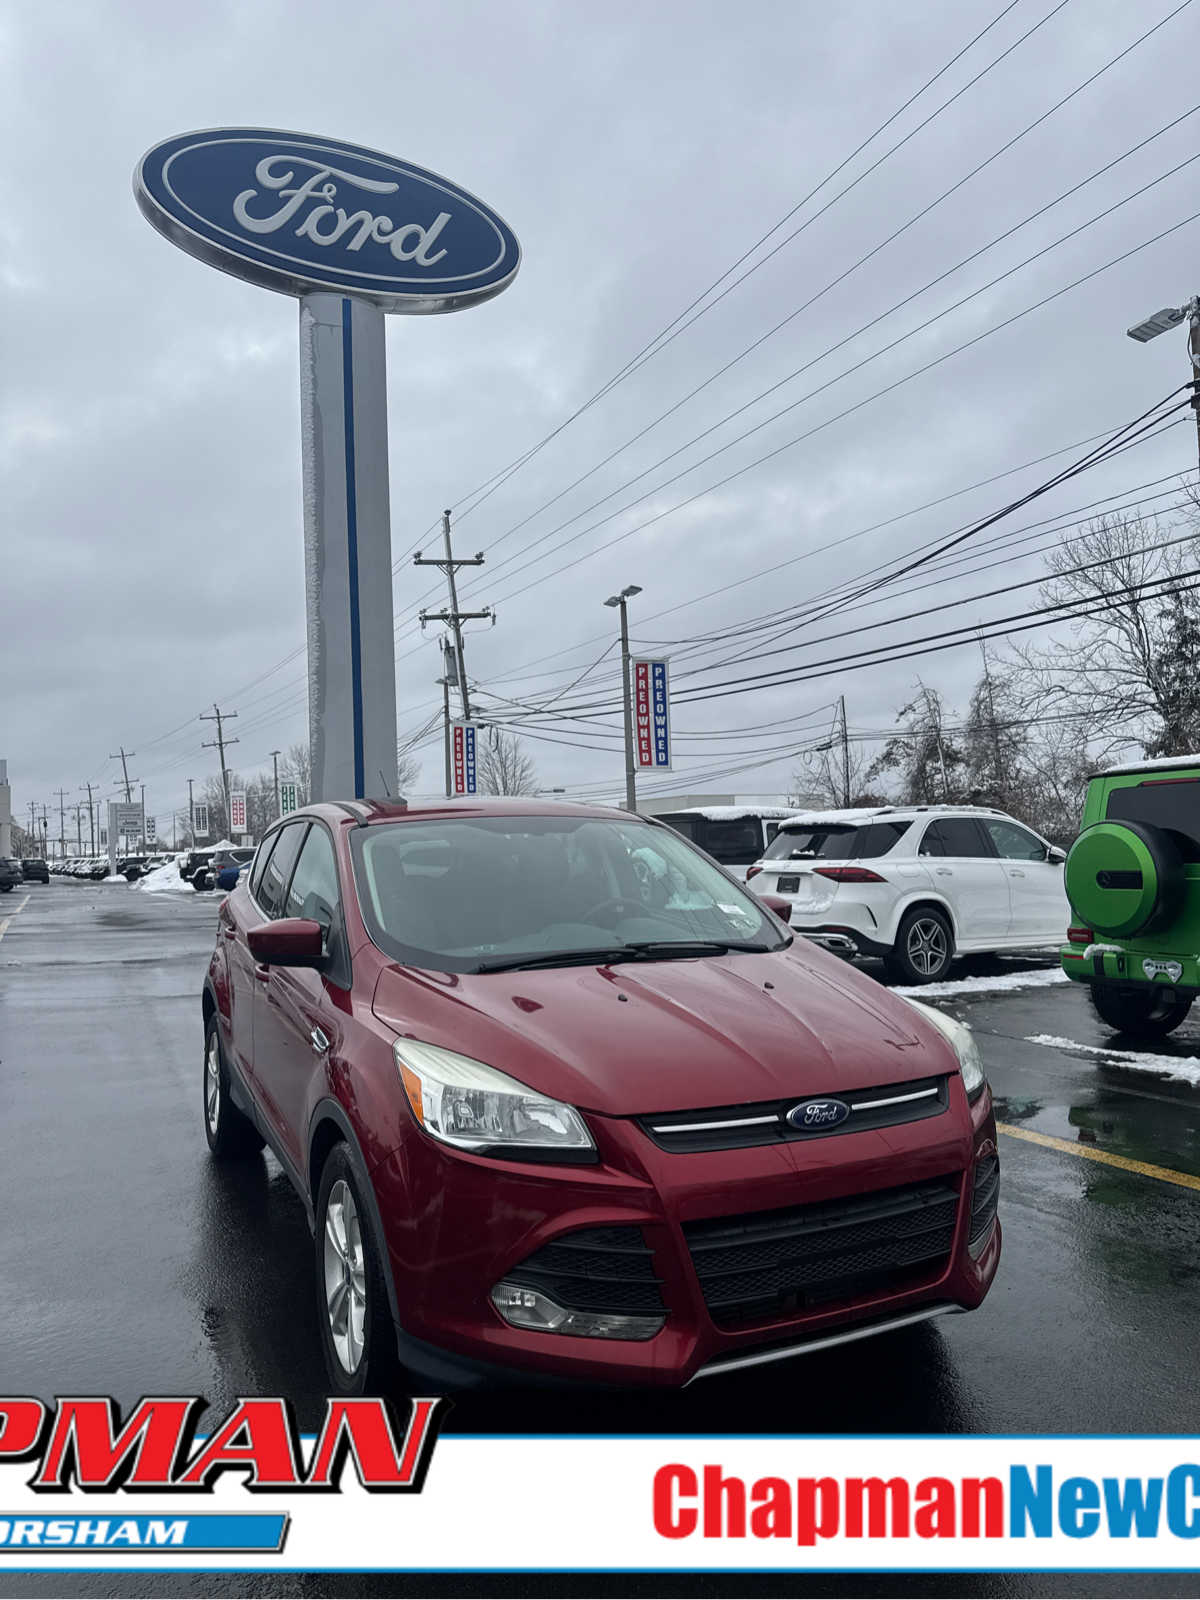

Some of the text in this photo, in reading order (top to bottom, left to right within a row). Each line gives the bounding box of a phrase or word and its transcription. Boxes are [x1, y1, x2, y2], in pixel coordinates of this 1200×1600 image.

[233, 155, 452, 267] Ford
[638, 667, 650, 762] PREOWNED
[655, 667, 666, 762] PREOWNED
[804, 1104, 838, 1125] Ford
